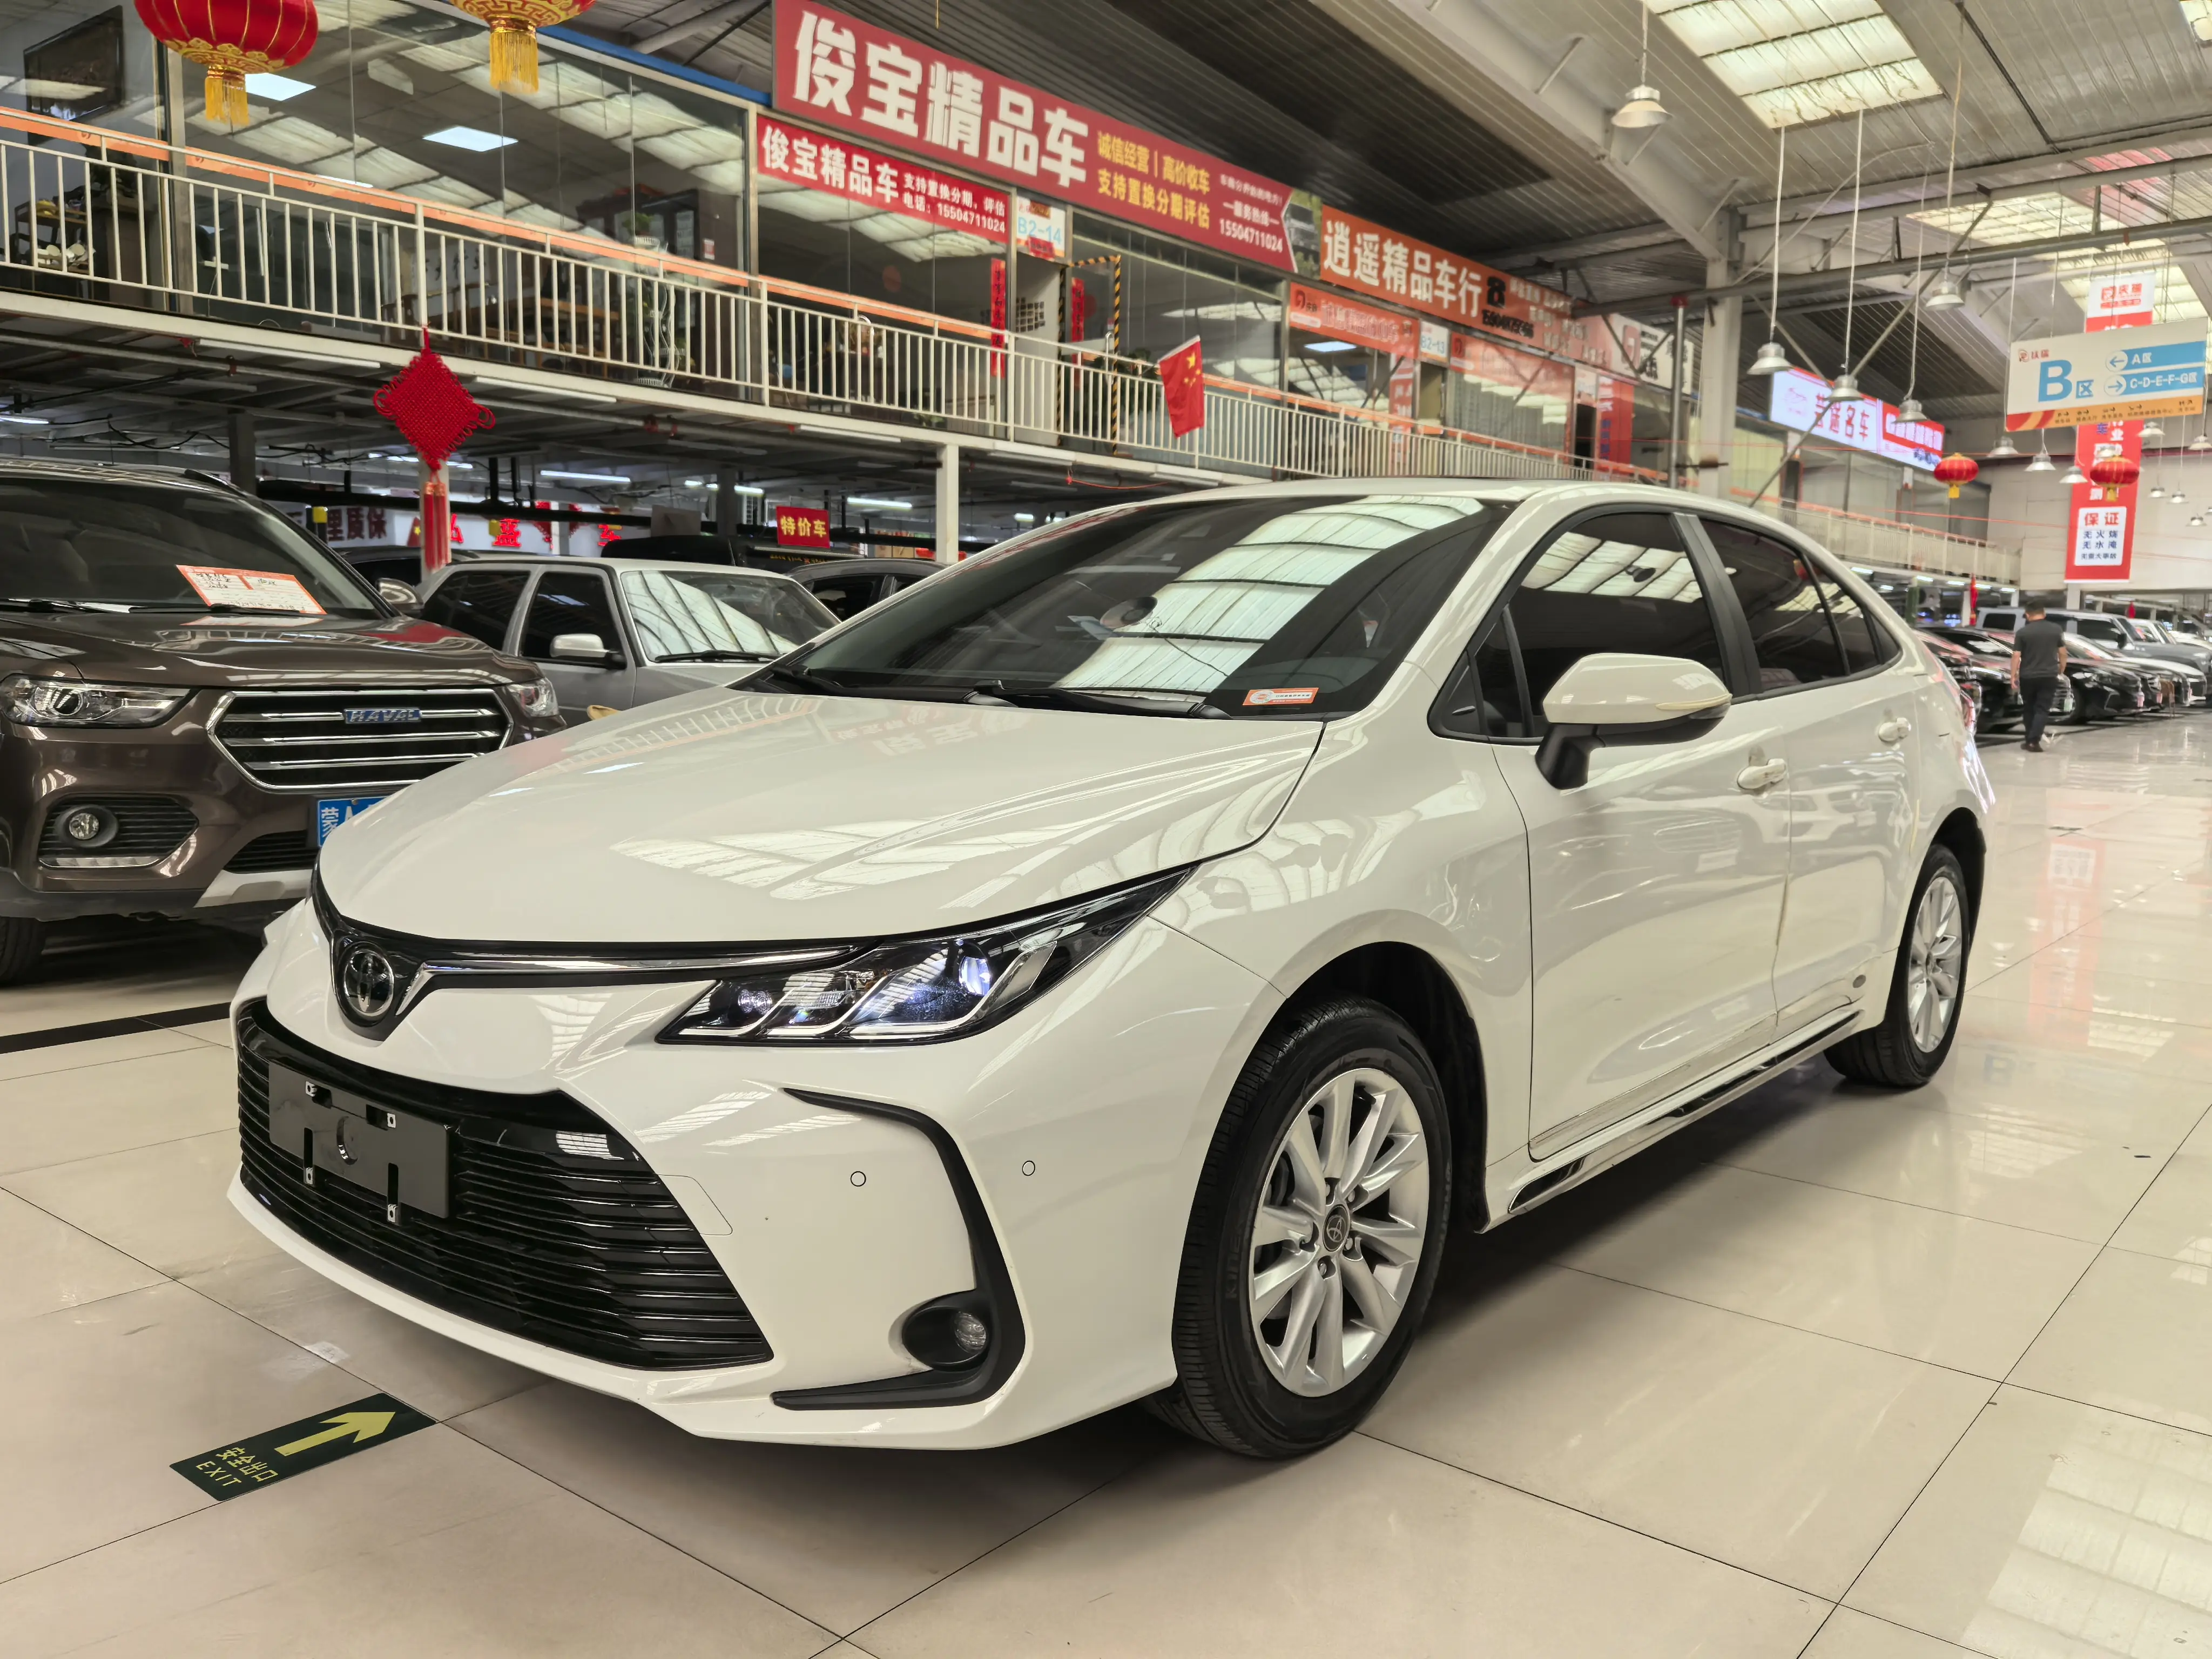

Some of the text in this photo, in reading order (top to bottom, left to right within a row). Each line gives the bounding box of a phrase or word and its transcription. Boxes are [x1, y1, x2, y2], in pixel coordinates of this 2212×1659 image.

[792, 11, 1088, 188] 俊宝精品车
[762, 125, 899, 204] 俊宝精品车
[1097, 168, 1210, 230] 支持置换分期评估
[1219, 218, 1283, 253] 15504711024
[1324, 220, 1482, 318] 逍遥精品车行
[2132, 352, 2152, 365] A区
[781, 516, 827, 538] 特价车
[2085, 512, 2120, 526] 保证
[350, 710, 420, 722] HAVAL
[195, 1460, 242, 1487] EXIT
[215, 1447, 278, 1482] 安全出口
